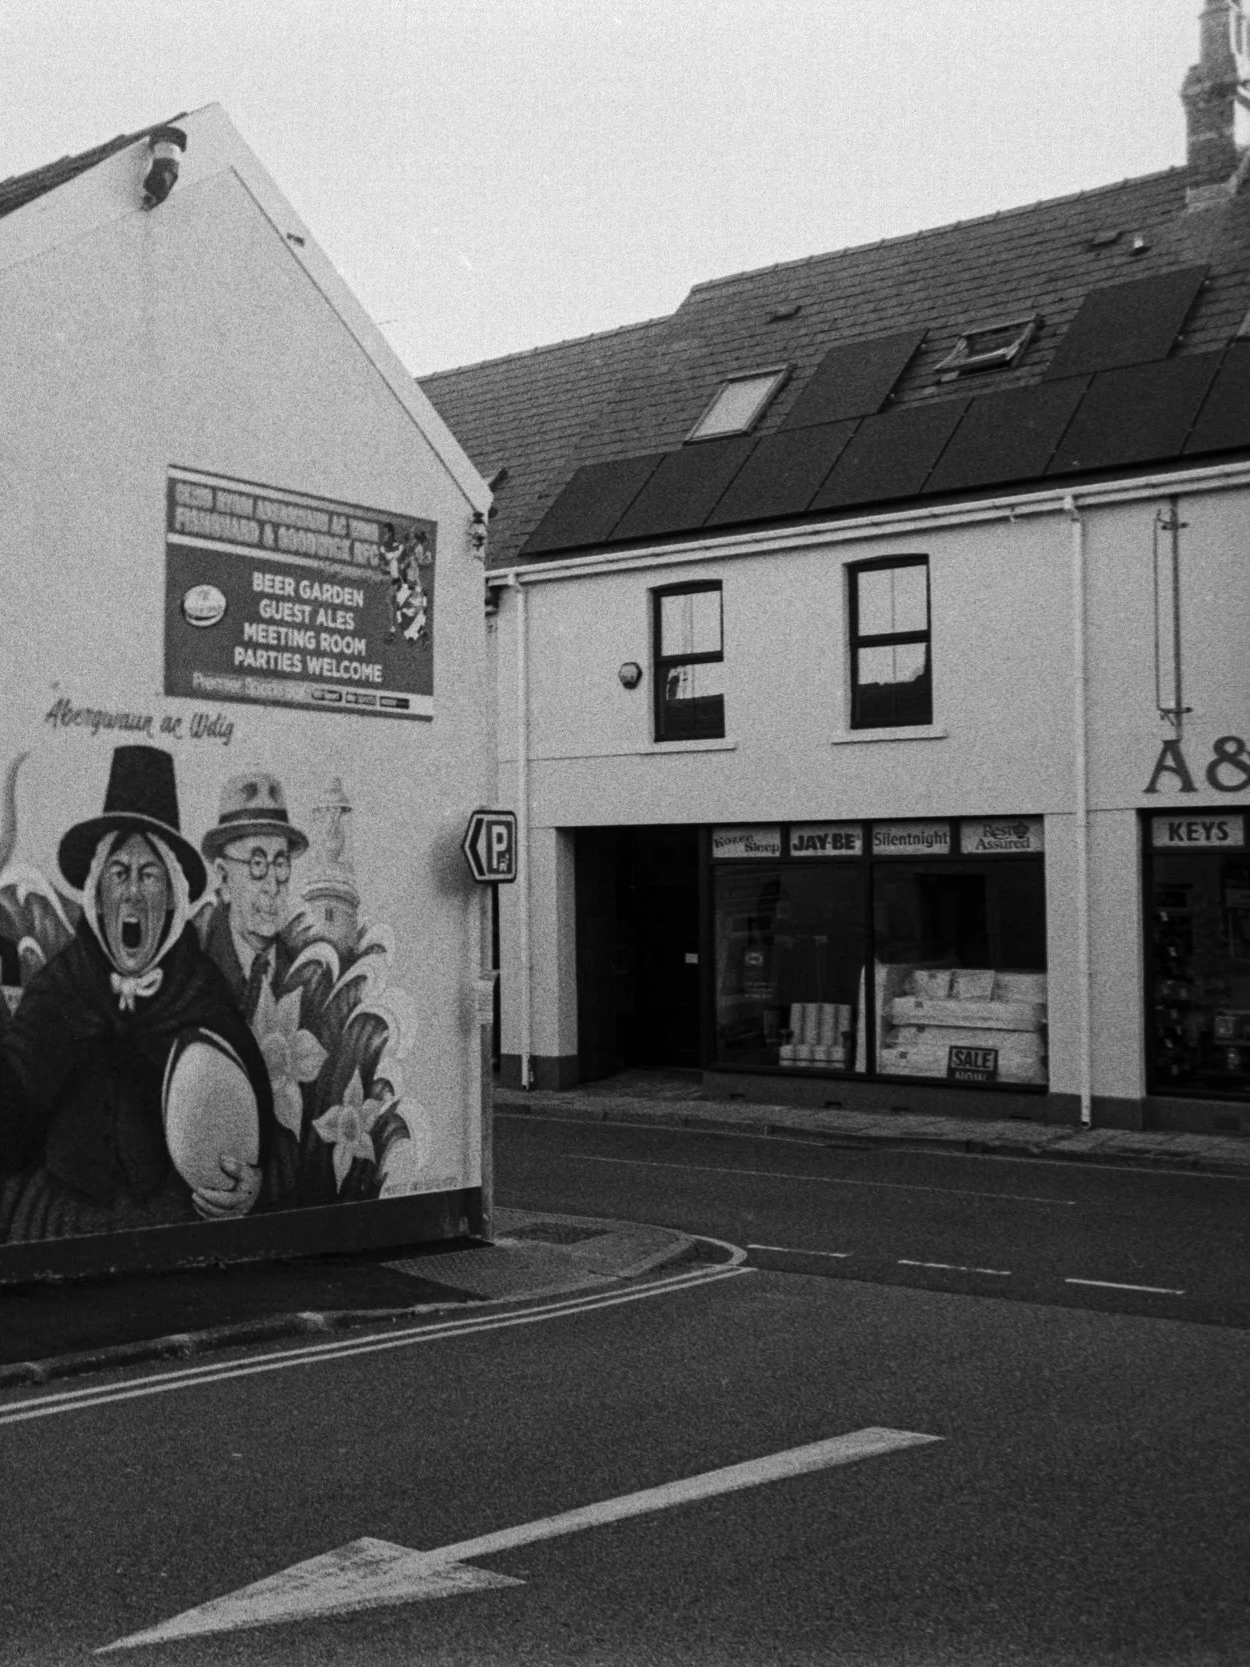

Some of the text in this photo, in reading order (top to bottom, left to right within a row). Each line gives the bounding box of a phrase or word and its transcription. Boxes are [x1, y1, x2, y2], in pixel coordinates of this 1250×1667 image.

[252, 571, 364, 608] BEER GARDEN
[259, 598, 355, 630] GUEST ALES
[243, 621, 367, 656] MEETING ROOM
[234, 645, 383, 682] PARTIES WELCOME
[492, 825, 508, 868] P
[873, 830, 948, 848] Silentnight
[975, 837, 1030, 850] Assured
[1168, 821, 1229, 842] KEYS
[954, 1050, 992, 1069] SALE
